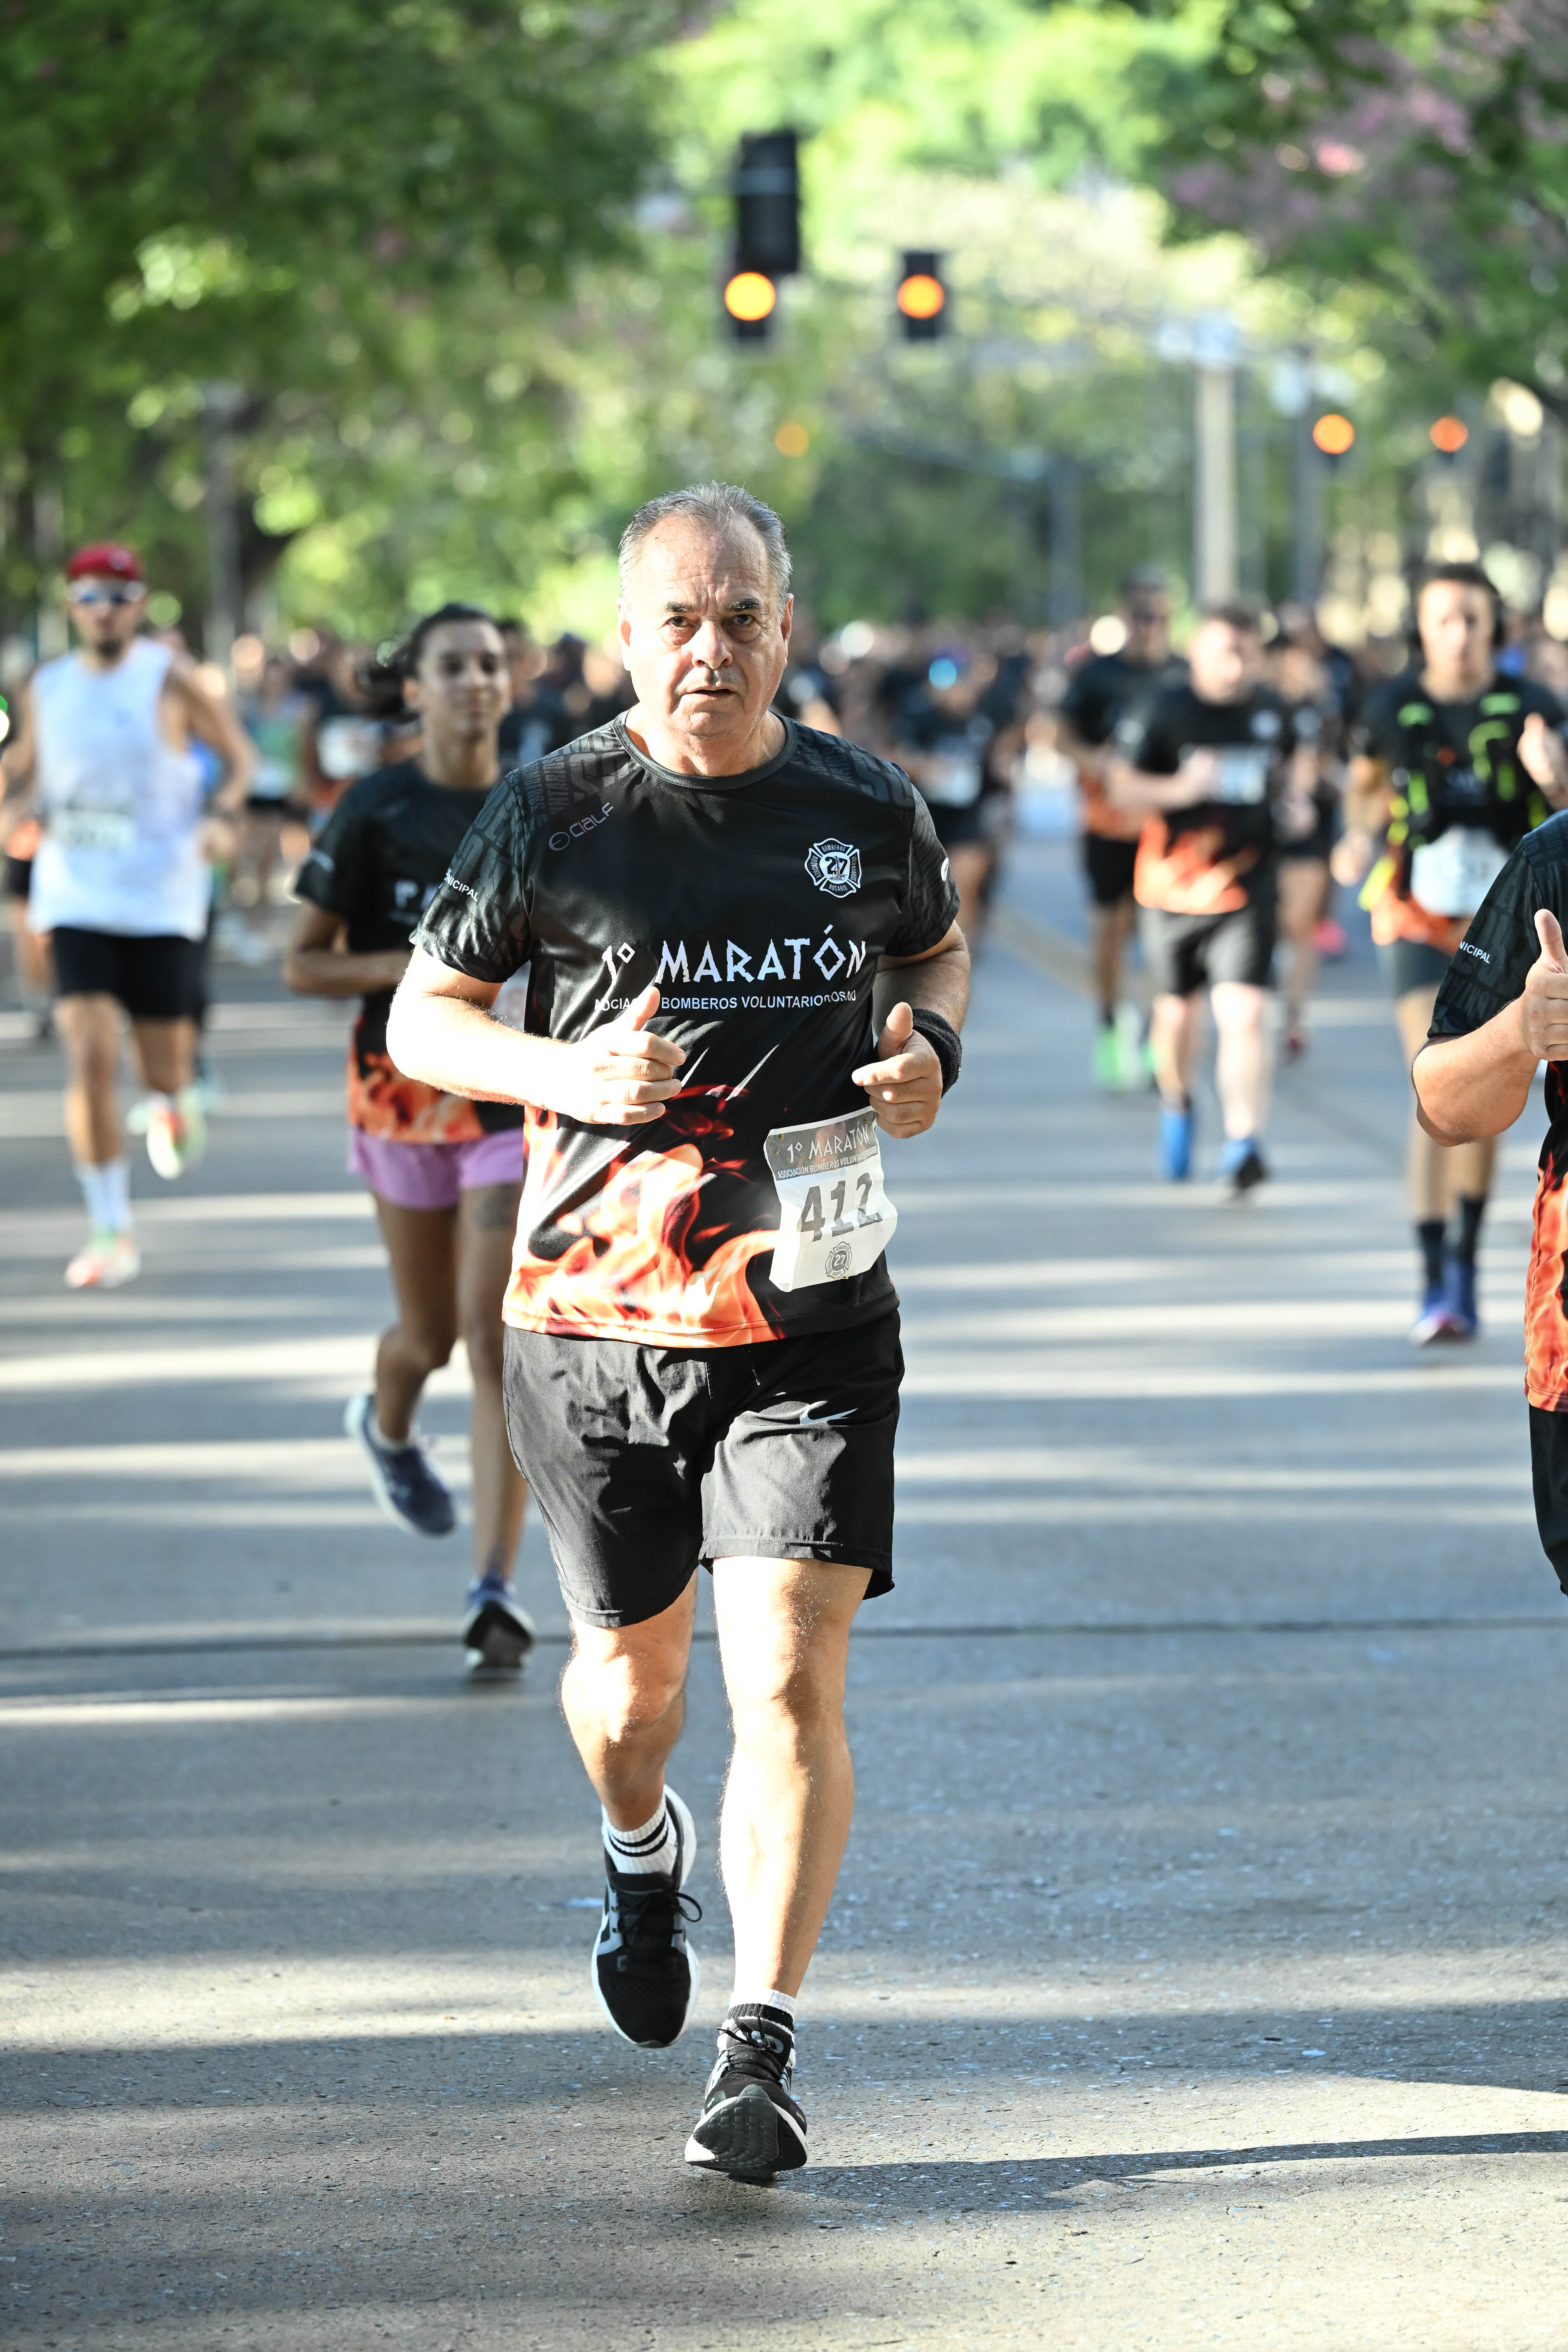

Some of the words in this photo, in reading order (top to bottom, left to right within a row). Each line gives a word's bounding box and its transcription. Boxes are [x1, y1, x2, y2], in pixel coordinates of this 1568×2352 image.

[821, 844, 846, 852] BOMBEROS
[824, 856, 848, 875] 27
[654, 924, 866, 984] MARATÓN
[662, 997, 737, 1010] BOMBEROS
[808, 1121, 870, 1160] MARATÓN
[778, 1165, 809, 1179] ASOCIACIÓN
[810, 1159, 839, 1174] BOMBEROS
[796, 1172, 883, 1242] 412
[833, 1254, 846, 1267] 27
